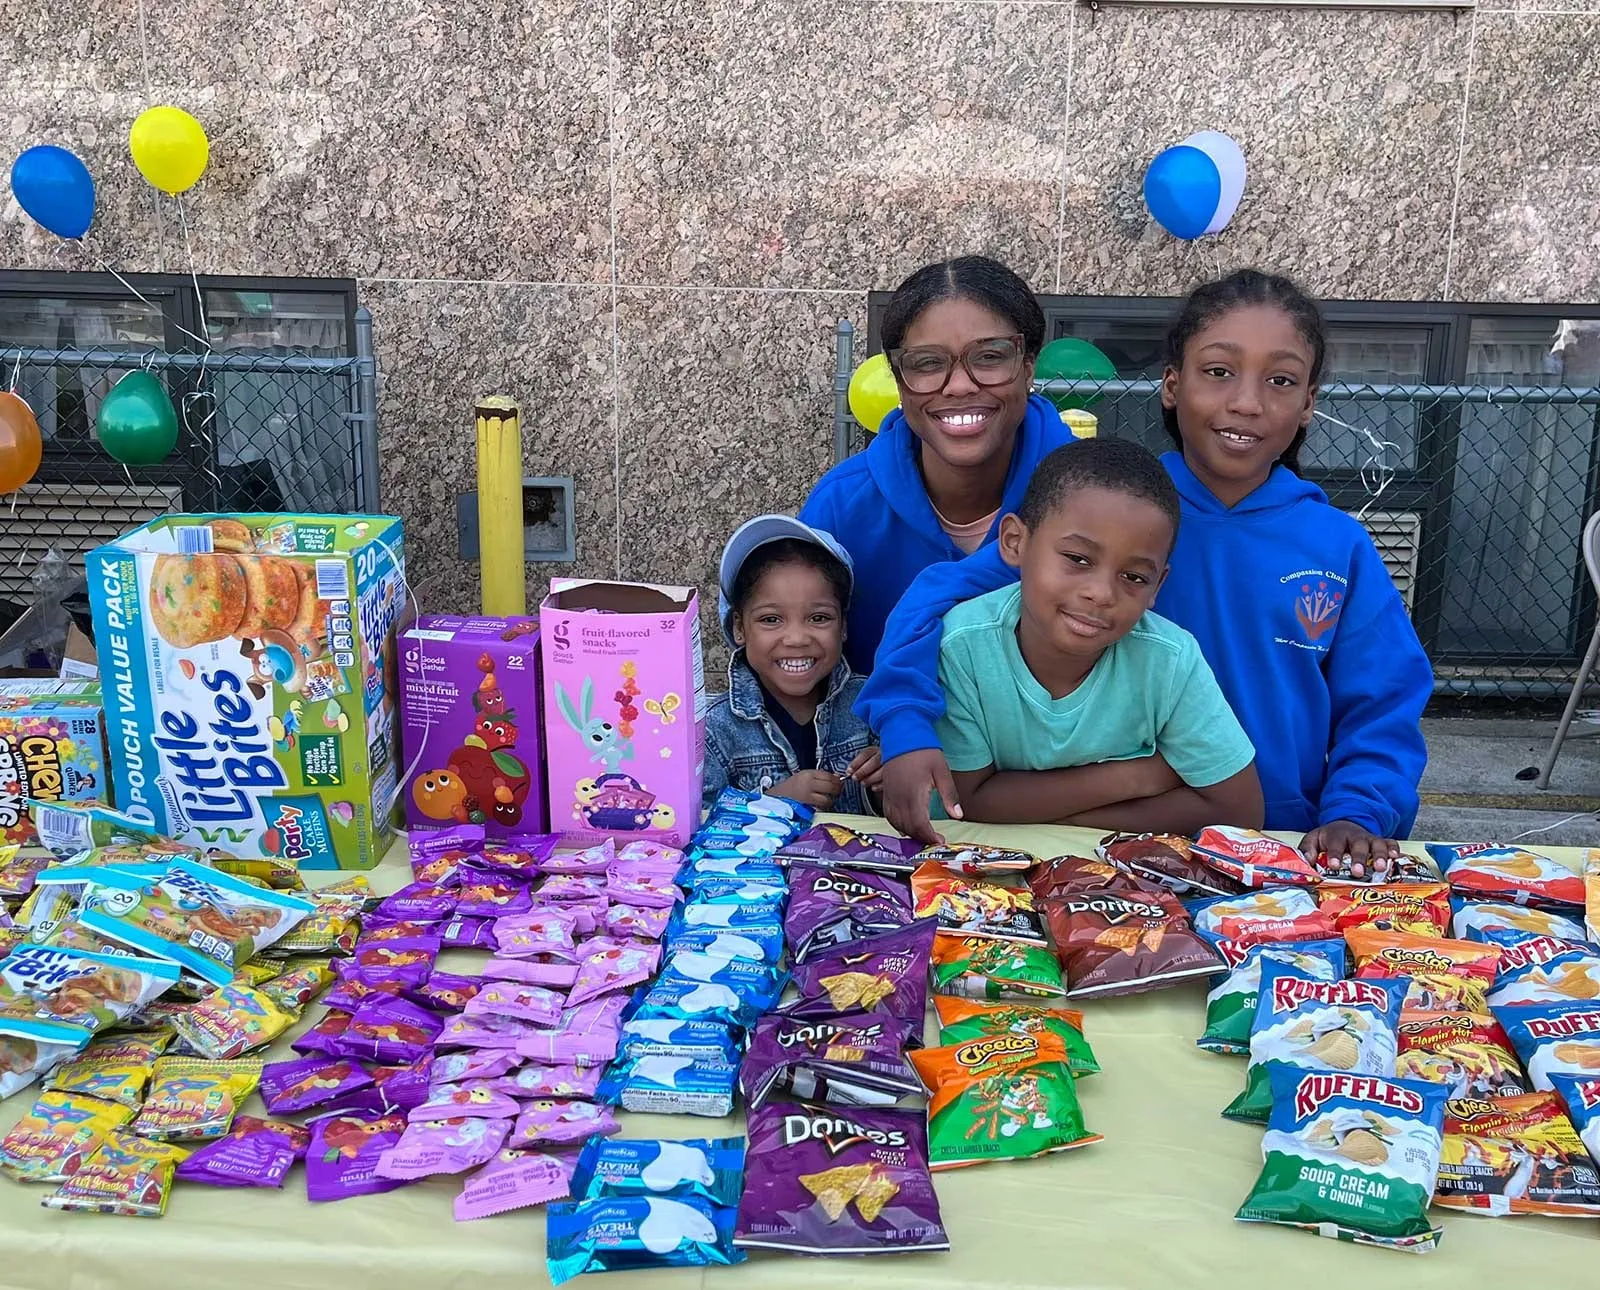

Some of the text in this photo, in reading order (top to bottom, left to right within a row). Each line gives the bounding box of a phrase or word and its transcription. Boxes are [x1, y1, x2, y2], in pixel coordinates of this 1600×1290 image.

[356, 547, 377, 585] 20
[659, 619, 676, 630] 32
[582, 639, 617, 648] snacks
[151, 637, 165, 694] LABELED FOR RESALE
[507, 655, 524, 667] 22
[101, 558, 148, 803] POUCH VALUE PACK
[405, 683, 460, 697] mixed fruit
[84, 719, 96, 734] 28
[201, 669, 288, 786] Bites
[326, 736, 335, 748] Fat
[14, 751, 28, 781] LIMITED
[153, 709, 253, 822] Little
[305, 750, 314, 774] No High
[312, 747, 321, 774] Fructose
[318, 741, 328, 774] Corn Syrup
[328, 748, 336, 764] Trans
[64, 766, 76, 797] QUAKER
[303, 818, 317, 847] CAKE
[310, 810, 329, 854] MUFFINS
[1232, 841, 1281, 852] CHEDDAR
[1068, 900, 1165, 917] Doritos
[1405, 904, 1422, 915] Hot
[1268, 920, 1295, 931] CREAM
[1381, 948, 1453, 970] Cheetos
[1488, 935, 1585, 976] RUFFL
[1243, 998, 1257, 1009] SO
[1273, 976, 1389, 1014] RUFFLES
[1451, 1027, 1472, 1038] Hot
[1522, 1010, 1600, 1039] RUFF
[957, 1037, 1038, 1066] Cheetos
[1295, 1073, 1425, 1123] RUFFLES
[1500, 1086, 1521, 1097] 160
[785, 1115, 906, 1147] Doritos
[596, 1161, 639, 1171] TREATS
[1474, 1166, 1494, 1177] SNACKS
[1300, 1166, 1390, 1200] SOUR CREAM
[1318, 1186, 1326, 1198] &
[1329, 1189, 1364, 1208] ONION
[750, 1223, 779, 1233] TORTILLA
